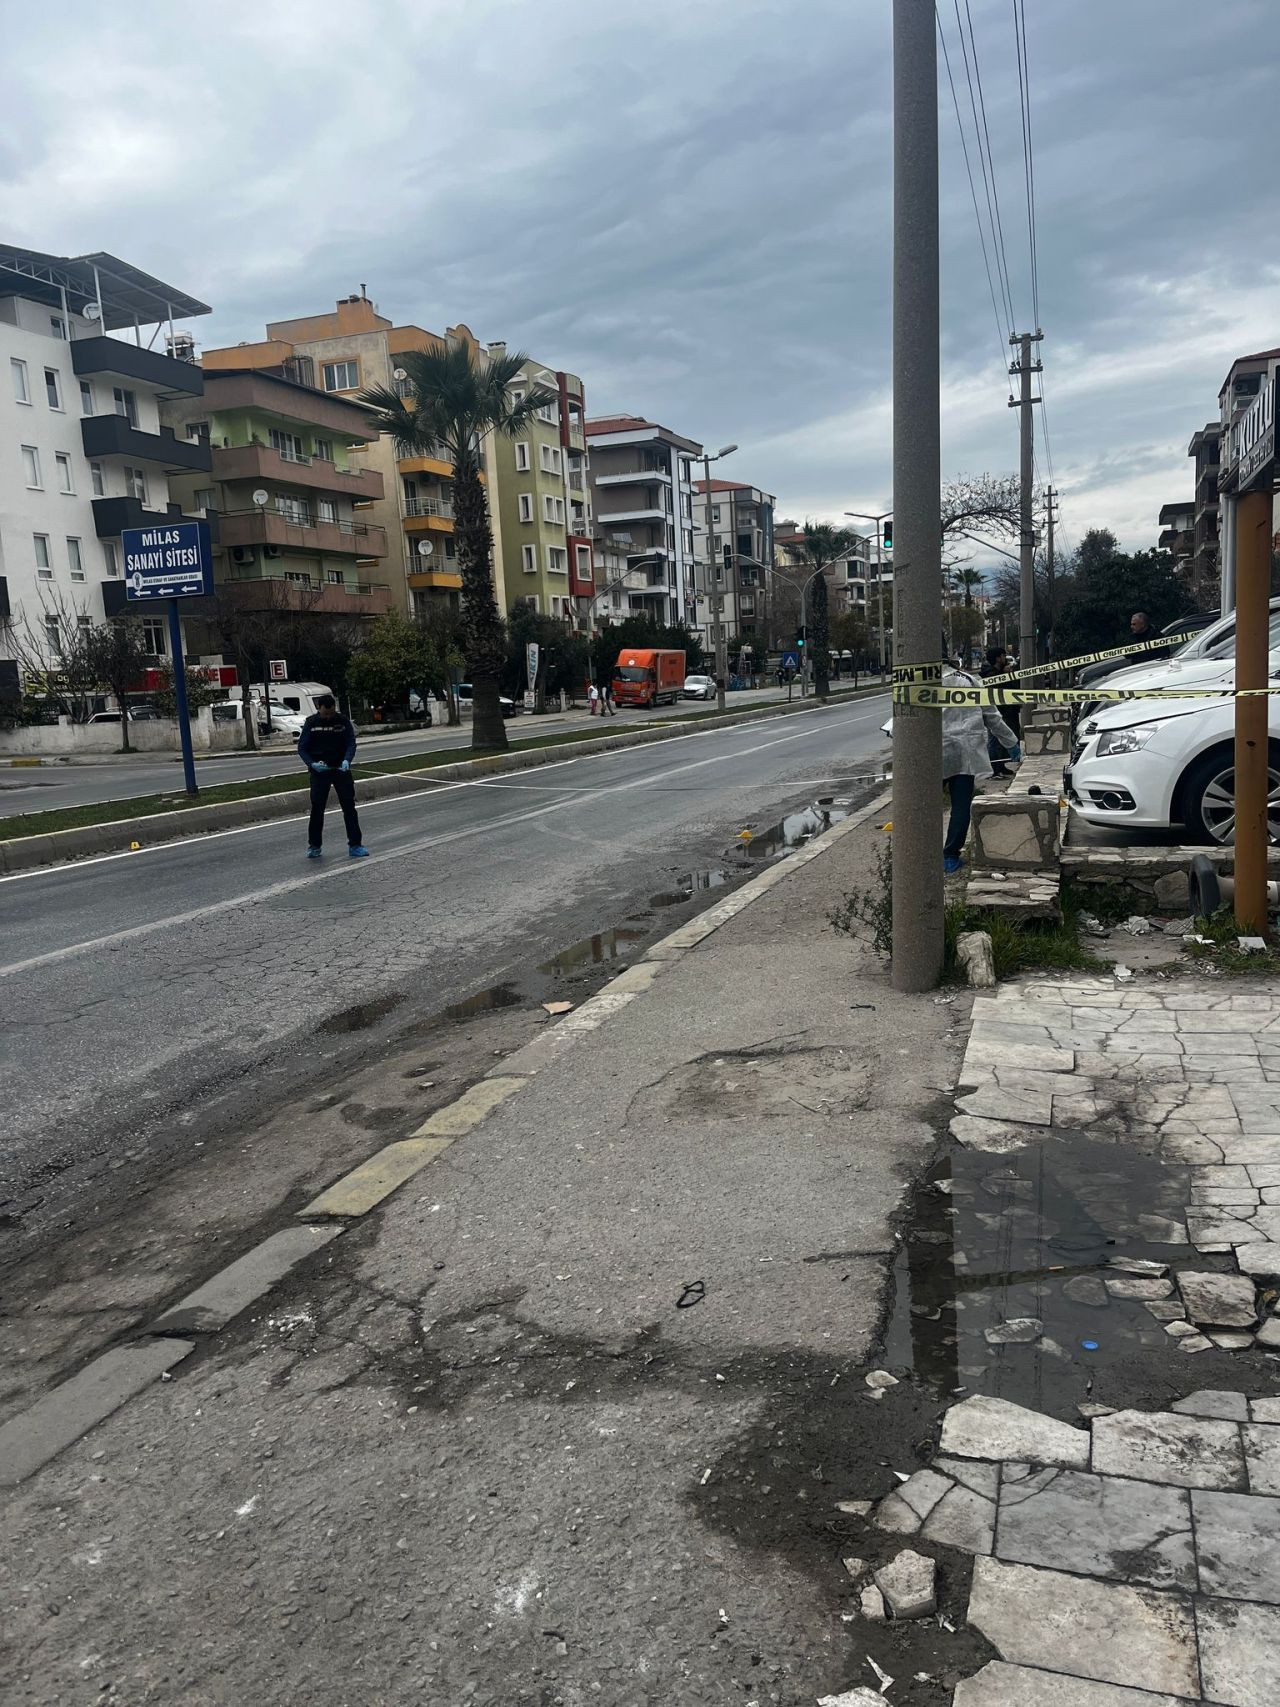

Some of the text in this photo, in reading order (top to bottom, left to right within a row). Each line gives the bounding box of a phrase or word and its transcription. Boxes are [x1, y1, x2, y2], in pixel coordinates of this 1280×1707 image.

[1240, 379, 1274, 461] KUTLU
[142, 530, 180, 546] MİLAS
[127, 545, 198, 571] SANAYİ SİTESİ
